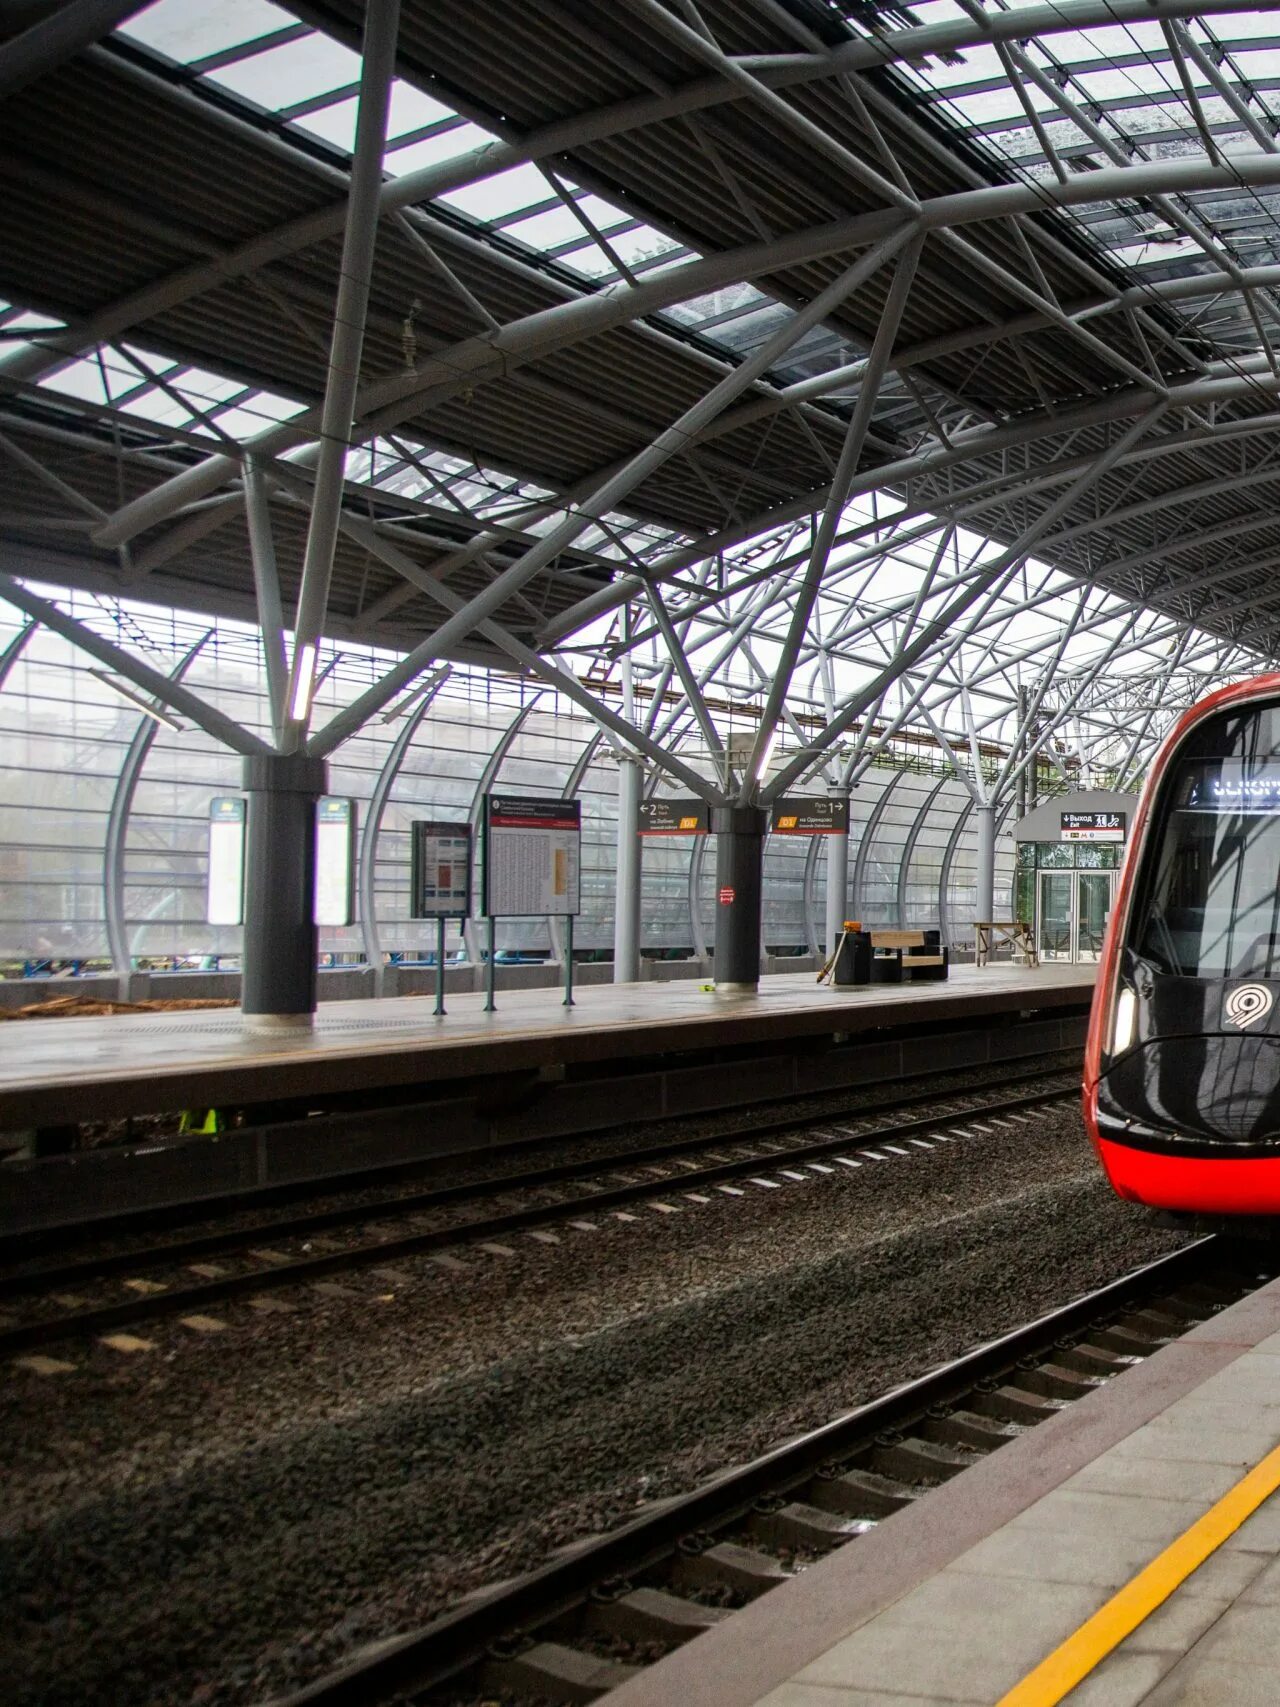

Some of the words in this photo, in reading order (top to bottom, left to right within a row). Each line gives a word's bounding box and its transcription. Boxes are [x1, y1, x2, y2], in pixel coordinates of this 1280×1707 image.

[650, 804, 657, 816] 2
[828, 802, 834, 814] 1
[1069, 814, 1093, 823] Выход
